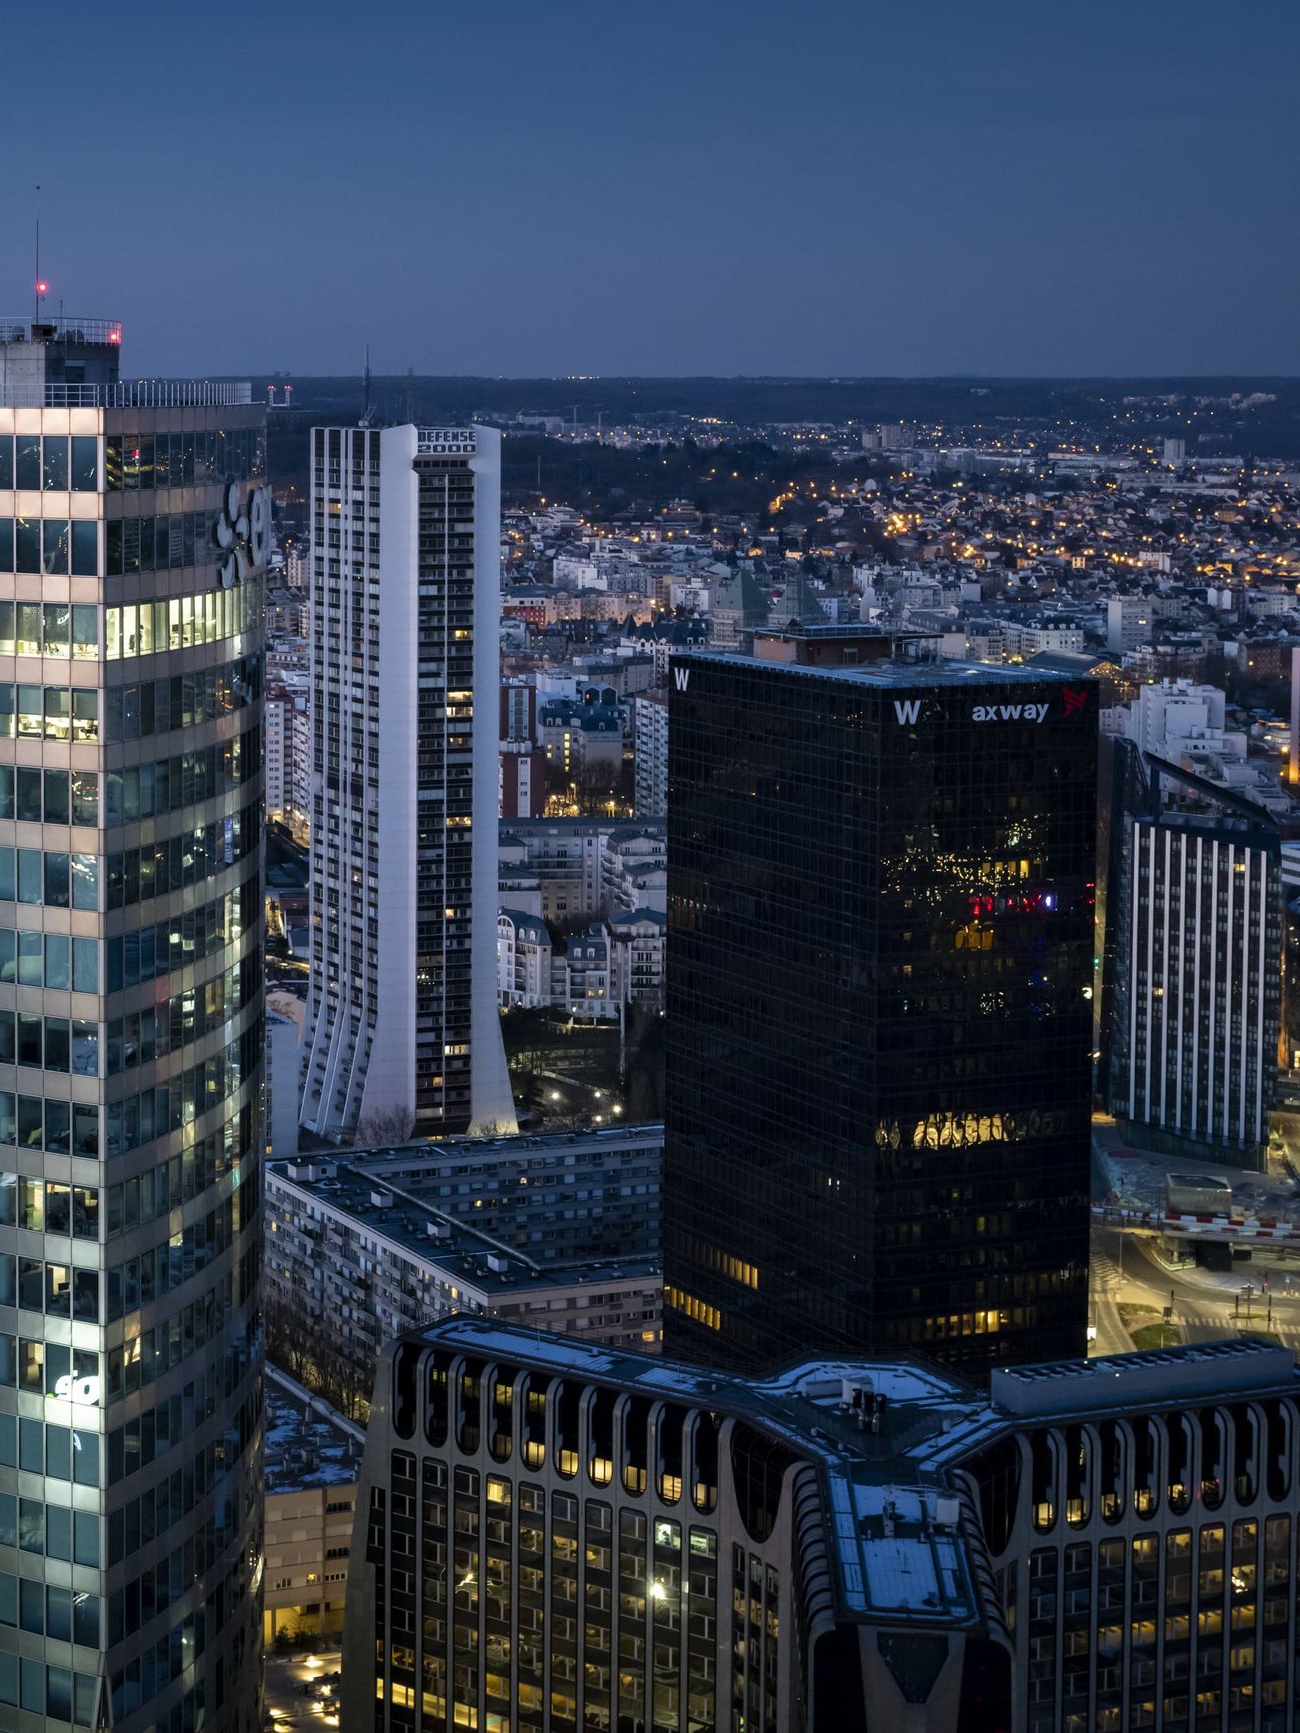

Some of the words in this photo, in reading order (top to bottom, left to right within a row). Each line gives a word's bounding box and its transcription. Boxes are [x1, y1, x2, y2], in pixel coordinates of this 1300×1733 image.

[418, 431, 476, 442] DEFENSE
[418, 444, 476, 454] 2000
[674, 667, 690, 691] W
[893, 700, 921, 726] W
[971, 703, 1049, 723] axway
